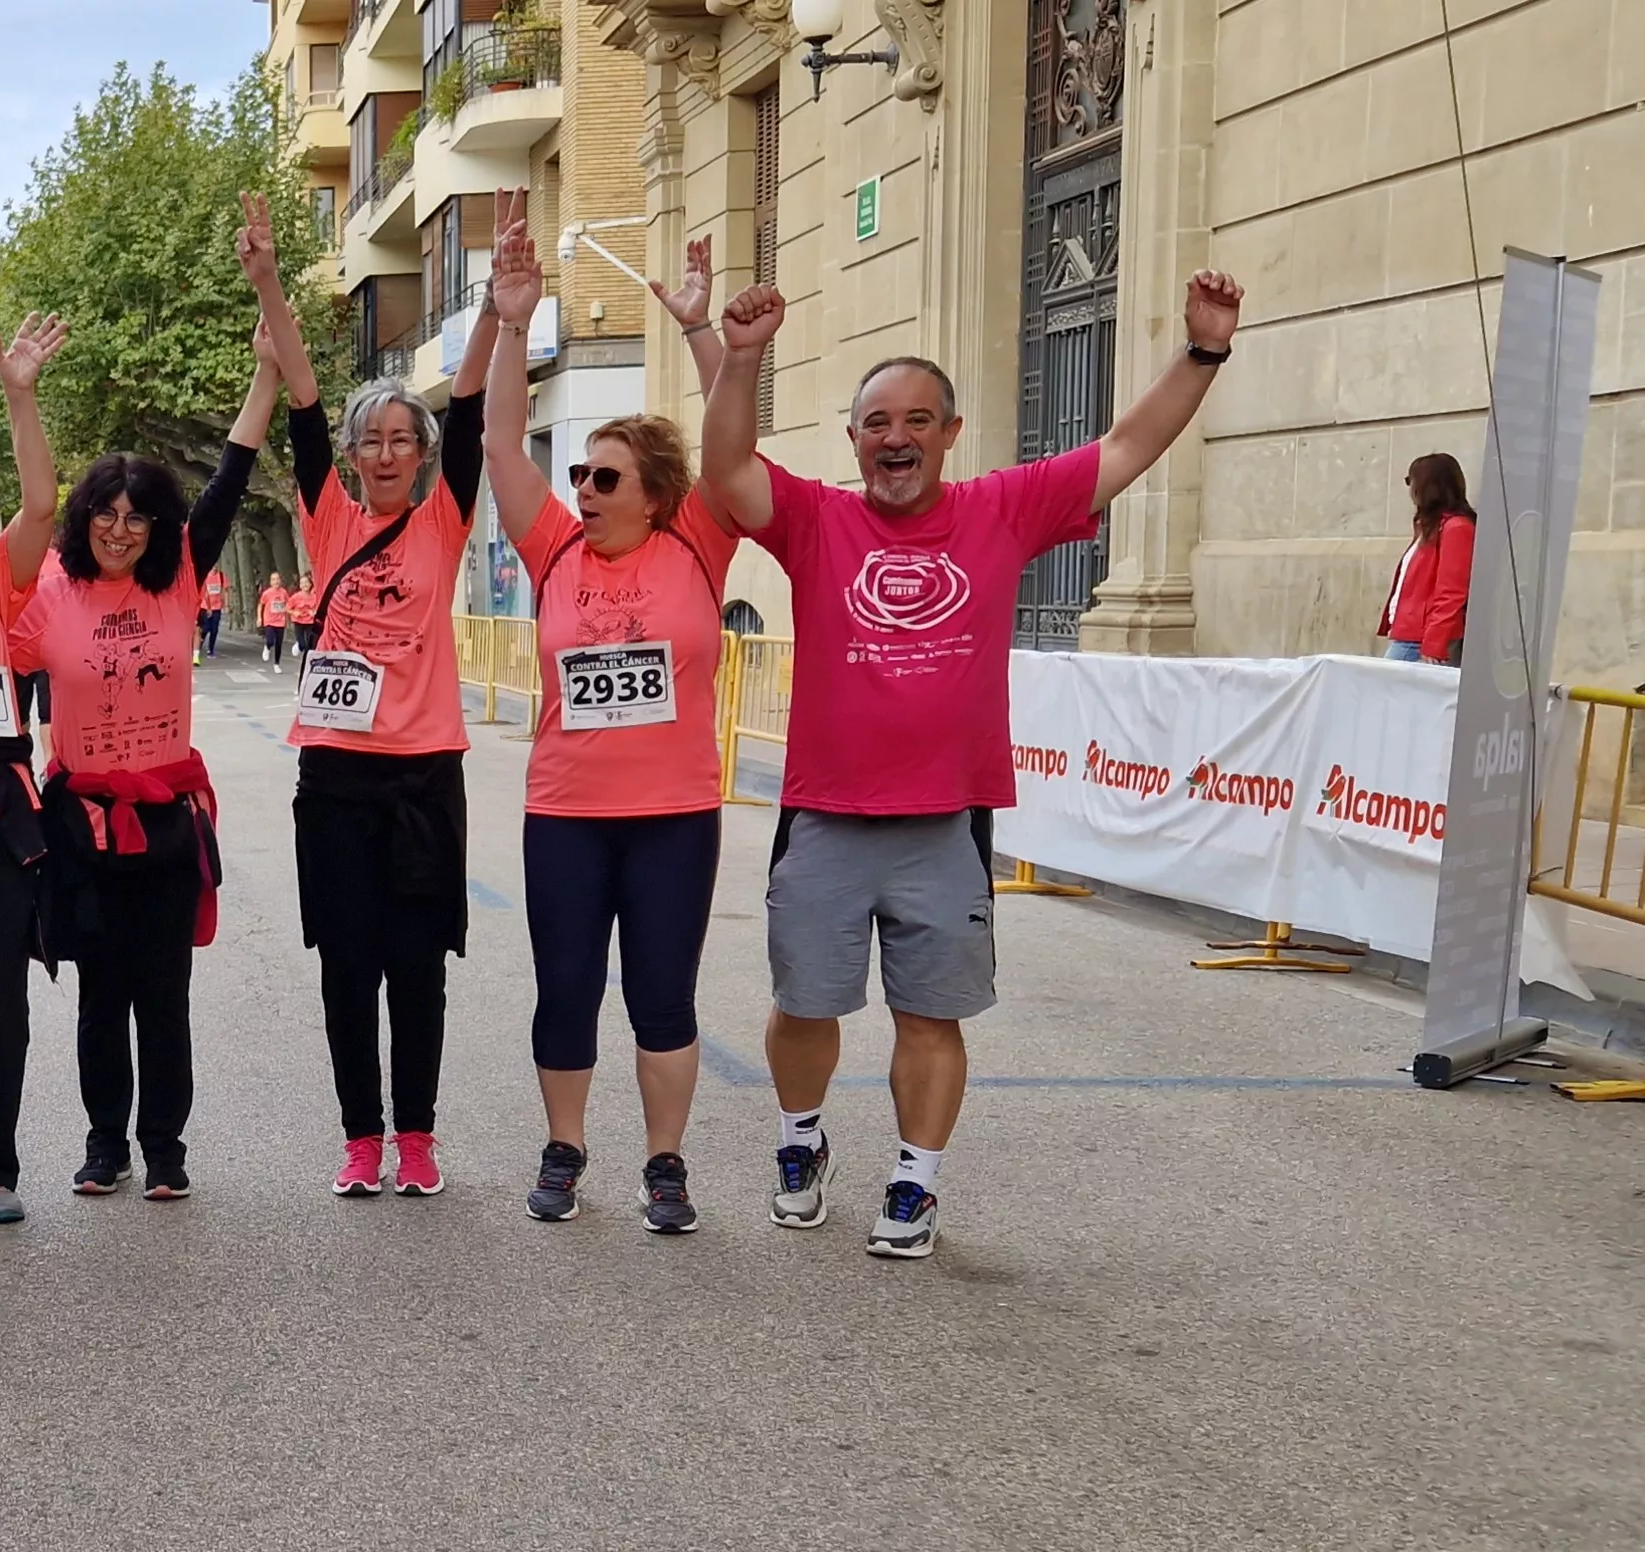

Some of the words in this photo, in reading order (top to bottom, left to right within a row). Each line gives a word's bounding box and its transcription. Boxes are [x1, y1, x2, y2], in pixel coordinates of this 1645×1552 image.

[570, 660, 607, 671] CONTRA
[609, 660, 620, 668] EL
[621, 656, 660, 667] CÁNCER
[311, 678, 360, 707] 486
[571, 668, 663, 705] 2938
[1082, 739, 1171, 801] Alcampo
[1186, 755, 1294, 817] Alcampo
[1316, 763, 1447, 844] Alcampo
